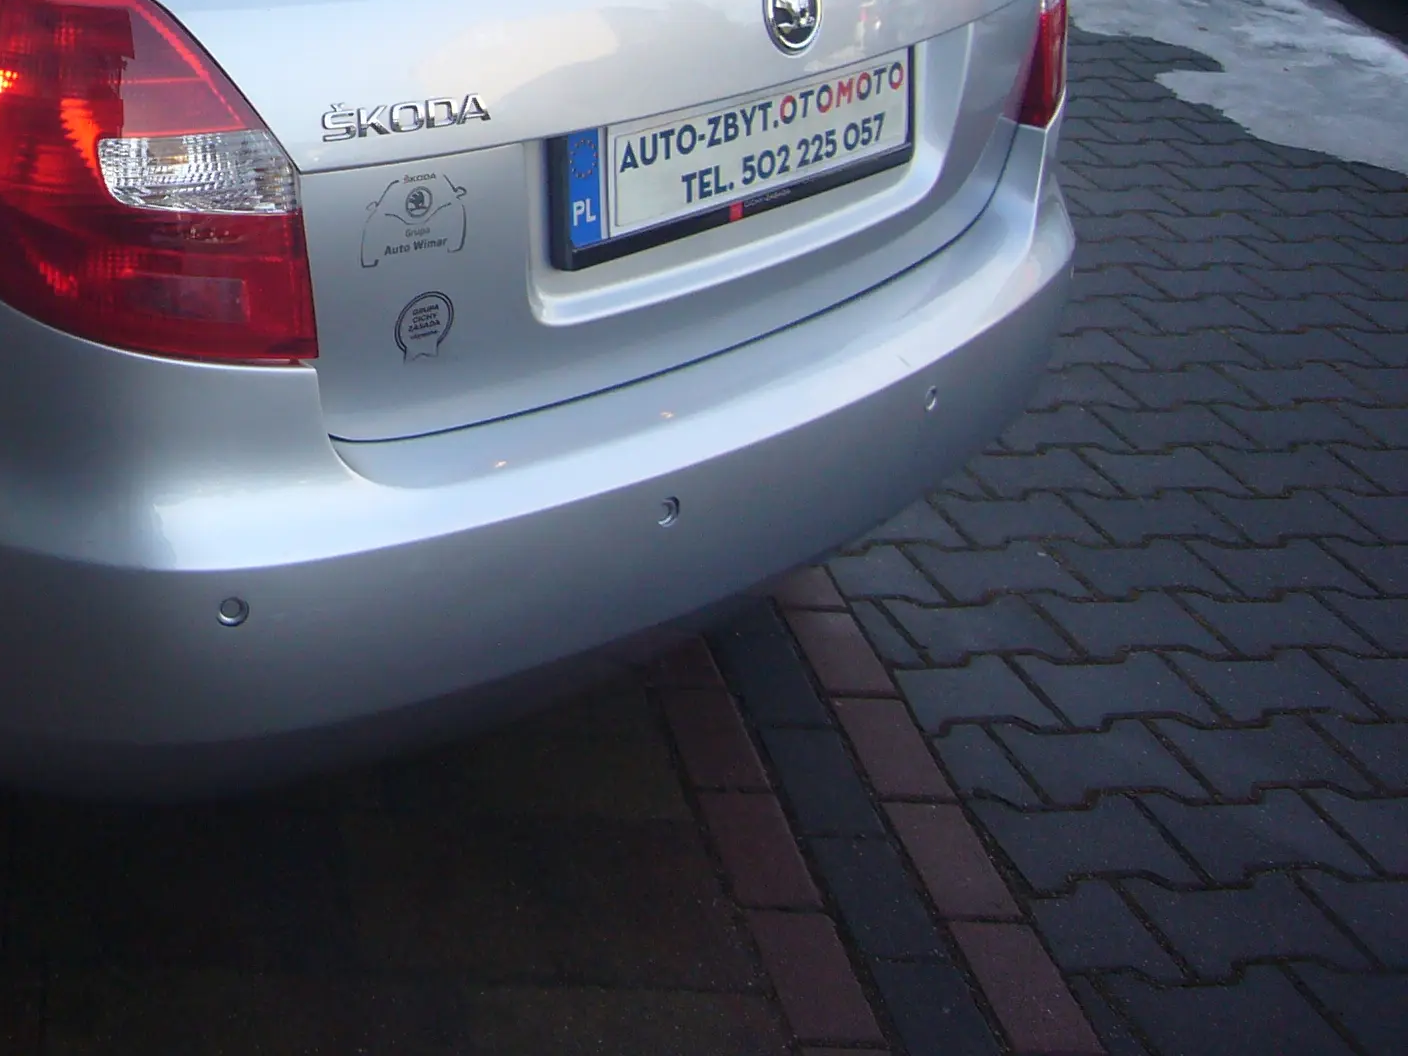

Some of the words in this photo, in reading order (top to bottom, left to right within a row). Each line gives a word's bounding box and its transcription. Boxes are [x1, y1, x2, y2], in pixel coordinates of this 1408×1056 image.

[322, 93, 491, 143] ŠKODA
[619, 61, 905, 174] AUTO-ZBYT.OTOMOTO
[681, 165, 735, 204] TEL.
[741, 144, 792, 186] 502
[796, 133, 838, 169] 225
[843, 111, 887, 152] 057
[573, 197, 597, 228] PL
[404, 227, 431, 238] Grupa
[384, 245, 411, 256] Auto
[413, 237, 448, 251] Wimar
[412, 304, 440, 315] GRUPA
[412, 313, 437, 324] CICHY
[407, 319, 441, 332] ZASADA
